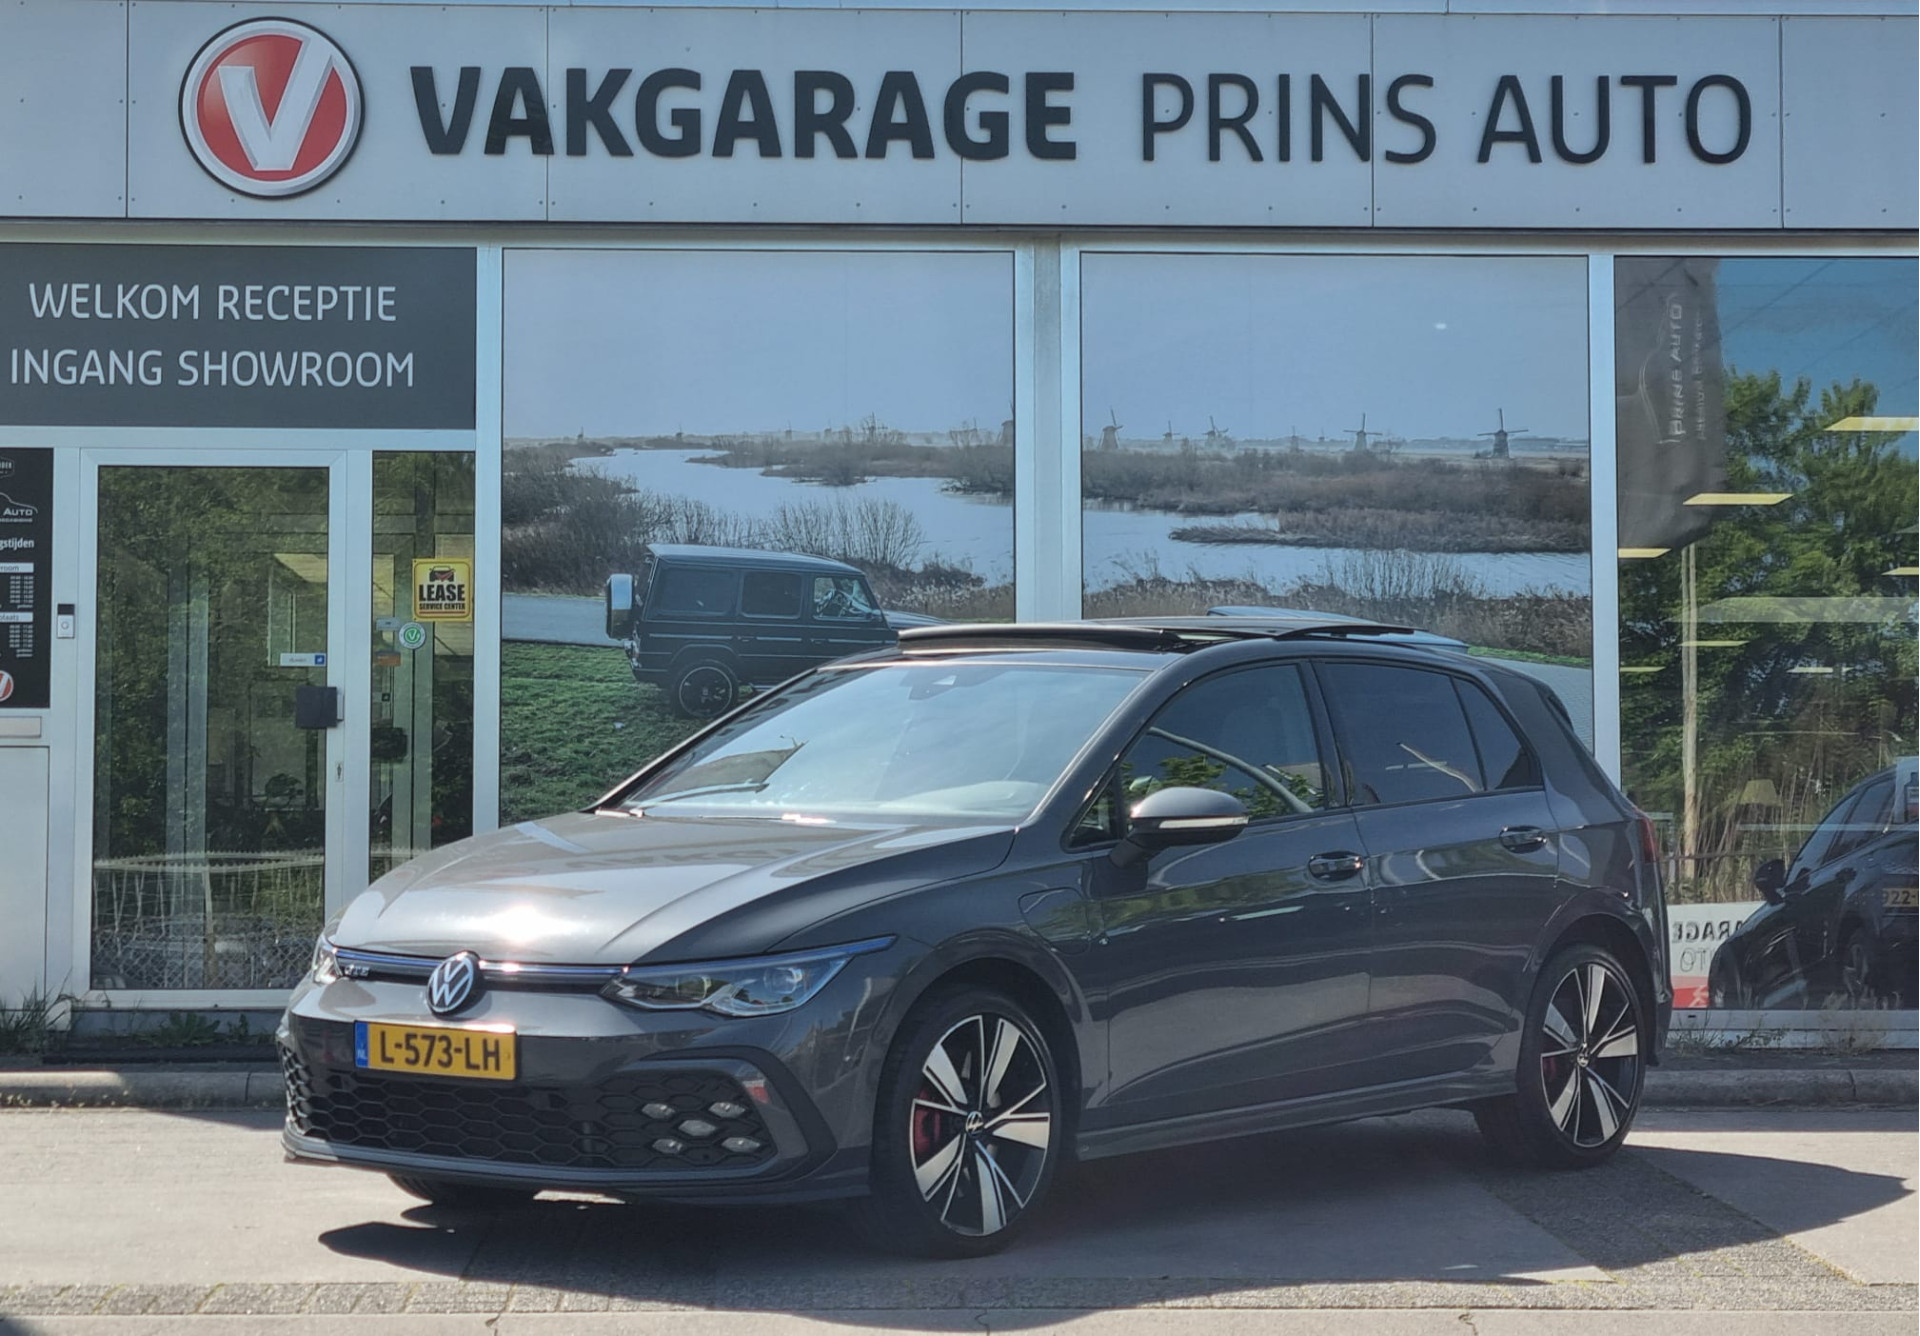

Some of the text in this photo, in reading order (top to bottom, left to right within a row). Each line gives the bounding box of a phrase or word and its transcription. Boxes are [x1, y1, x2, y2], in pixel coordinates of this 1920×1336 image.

[409, 66, 1752, 165] VAKGARAGE PRINS AUTO
[29, 283, 396, 322] WELKOM RECEPTIE
[11, 348, 413, 389] INGANG SHOWROOM
[2, 507, 33, 517] AUTO
[418, 583, 465, 602] LEASE
[418, 602, 466, 611] SERVICE CENTER
[356, 1030, 502, 1073] NL L-573-LH
